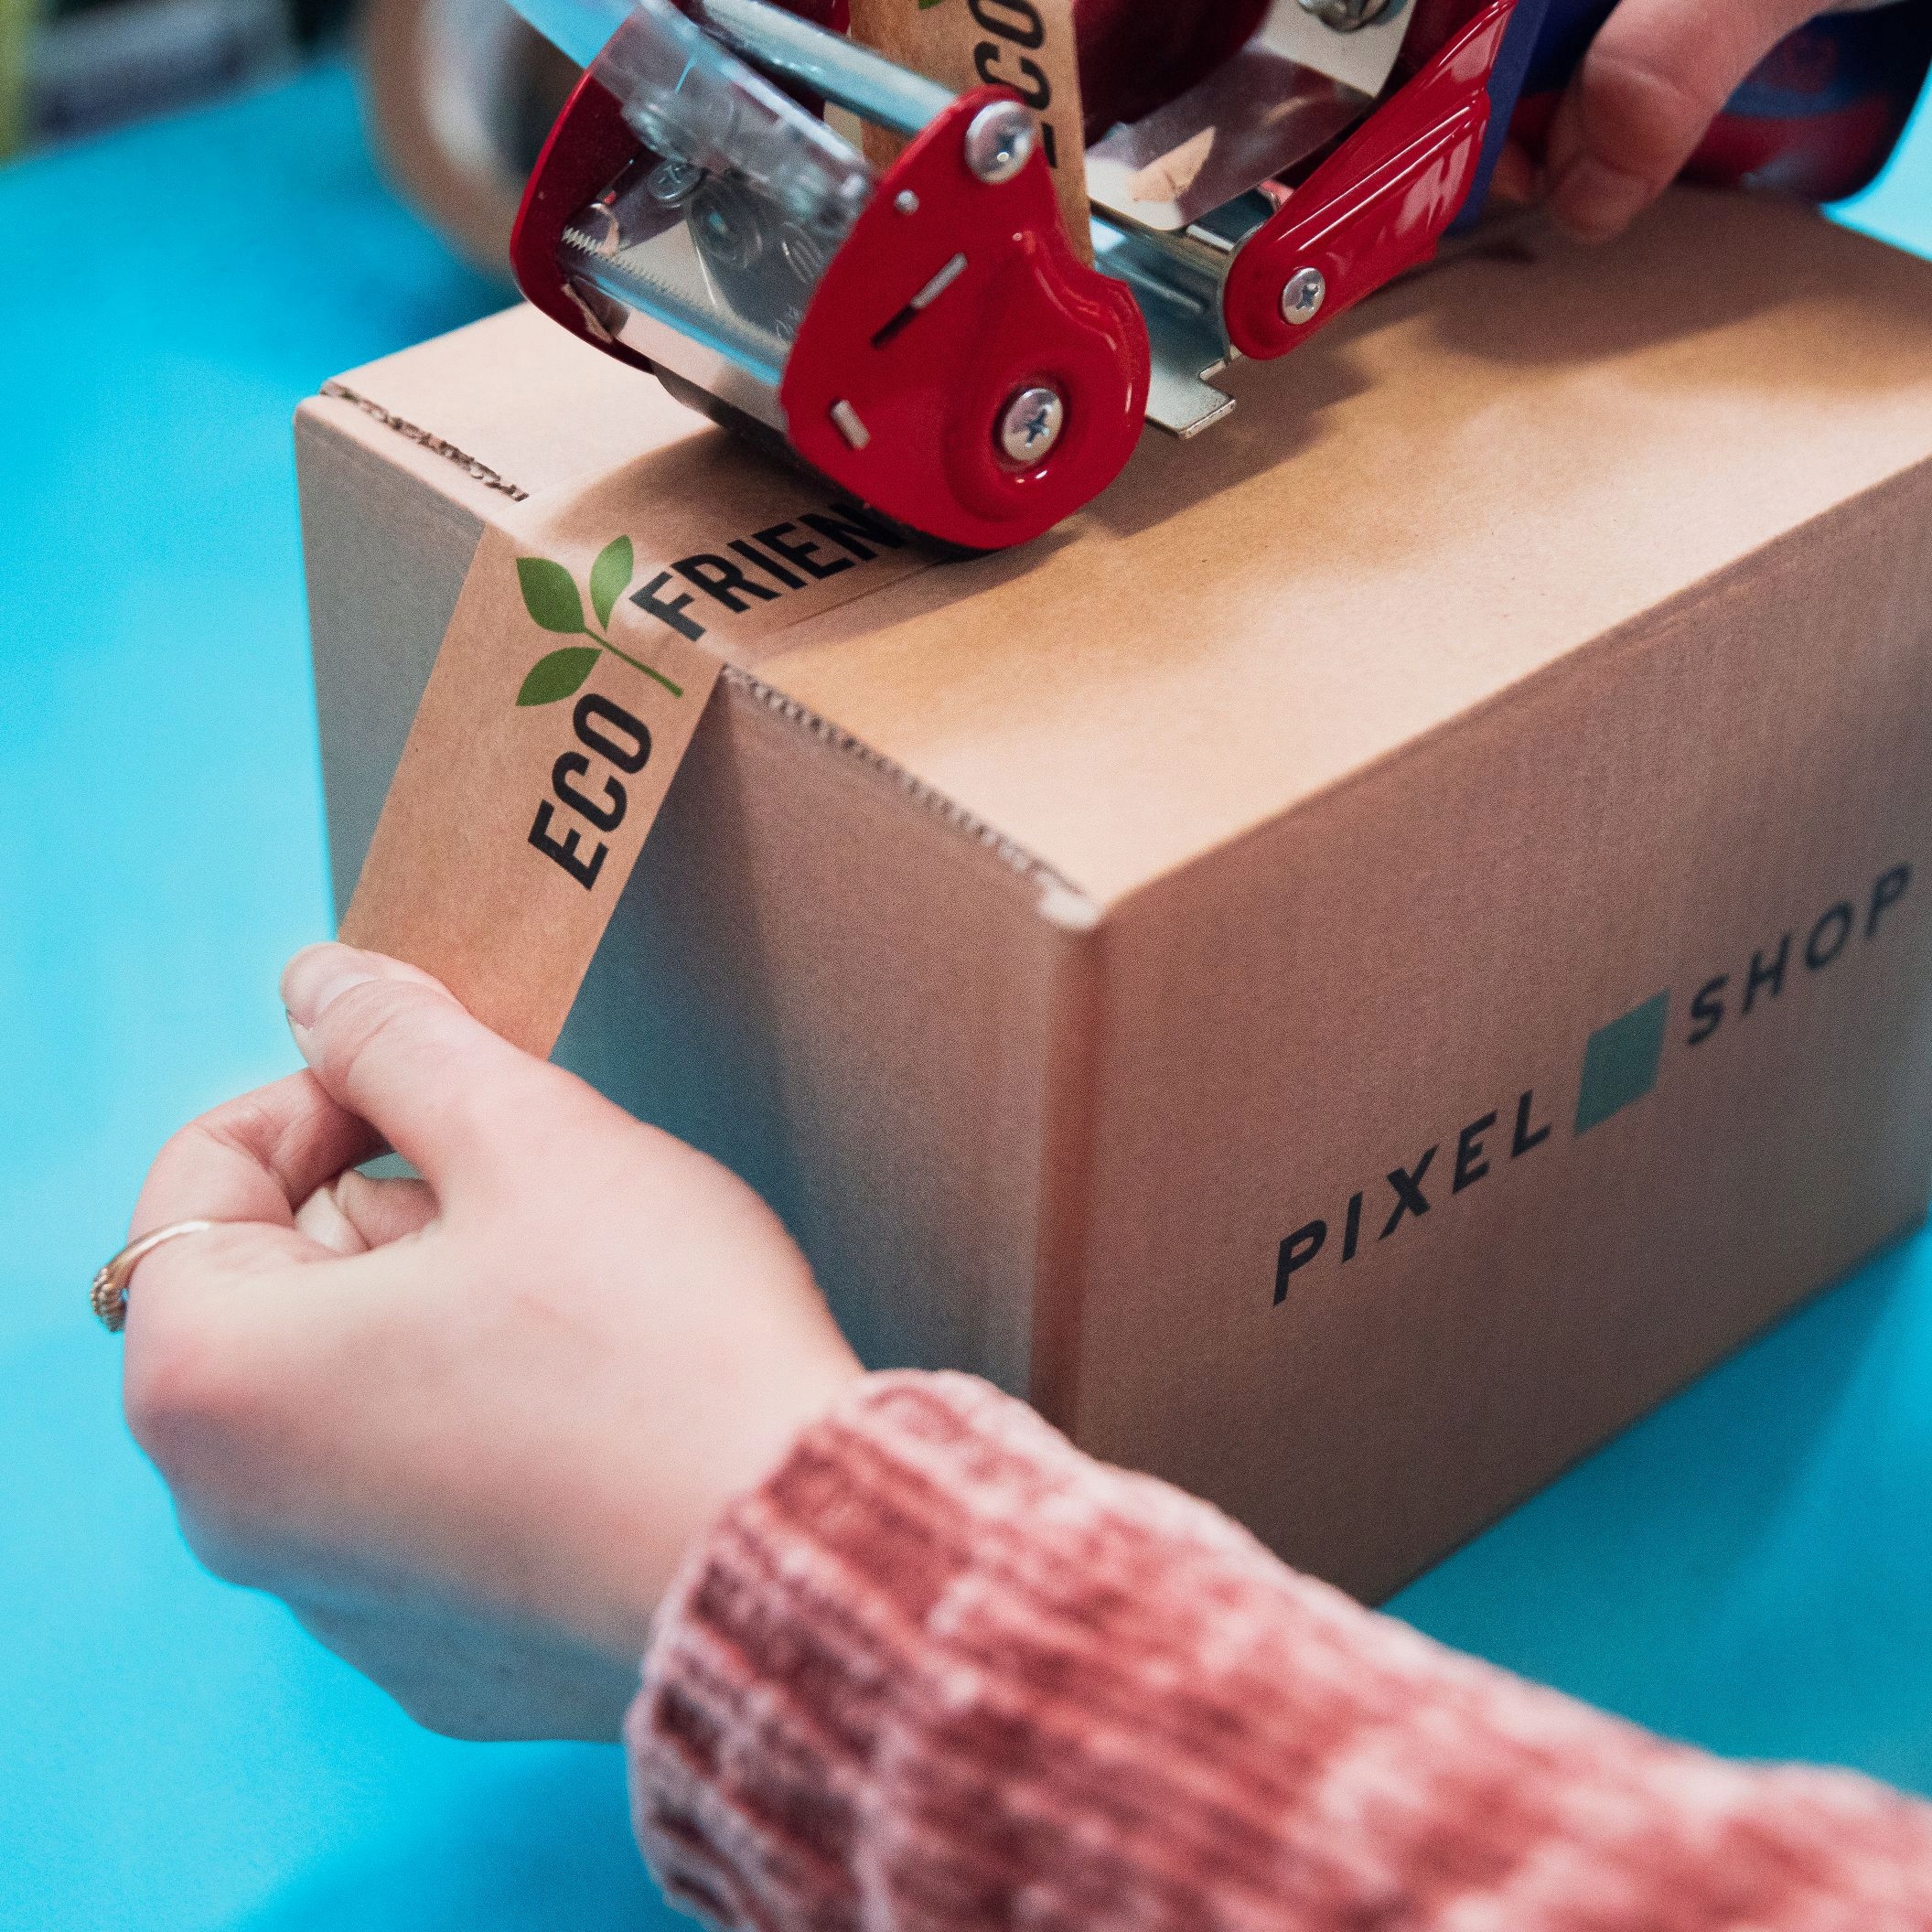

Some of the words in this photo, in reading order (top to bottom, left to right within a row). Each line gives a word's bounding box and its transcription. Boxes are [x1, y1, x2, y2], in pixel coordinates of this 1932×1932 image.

[528, 692, 652, 892] ECO
[1272, 1089, 1551, 1307] PIXEL
[1686, 861, 1913, 1046] SHOP
